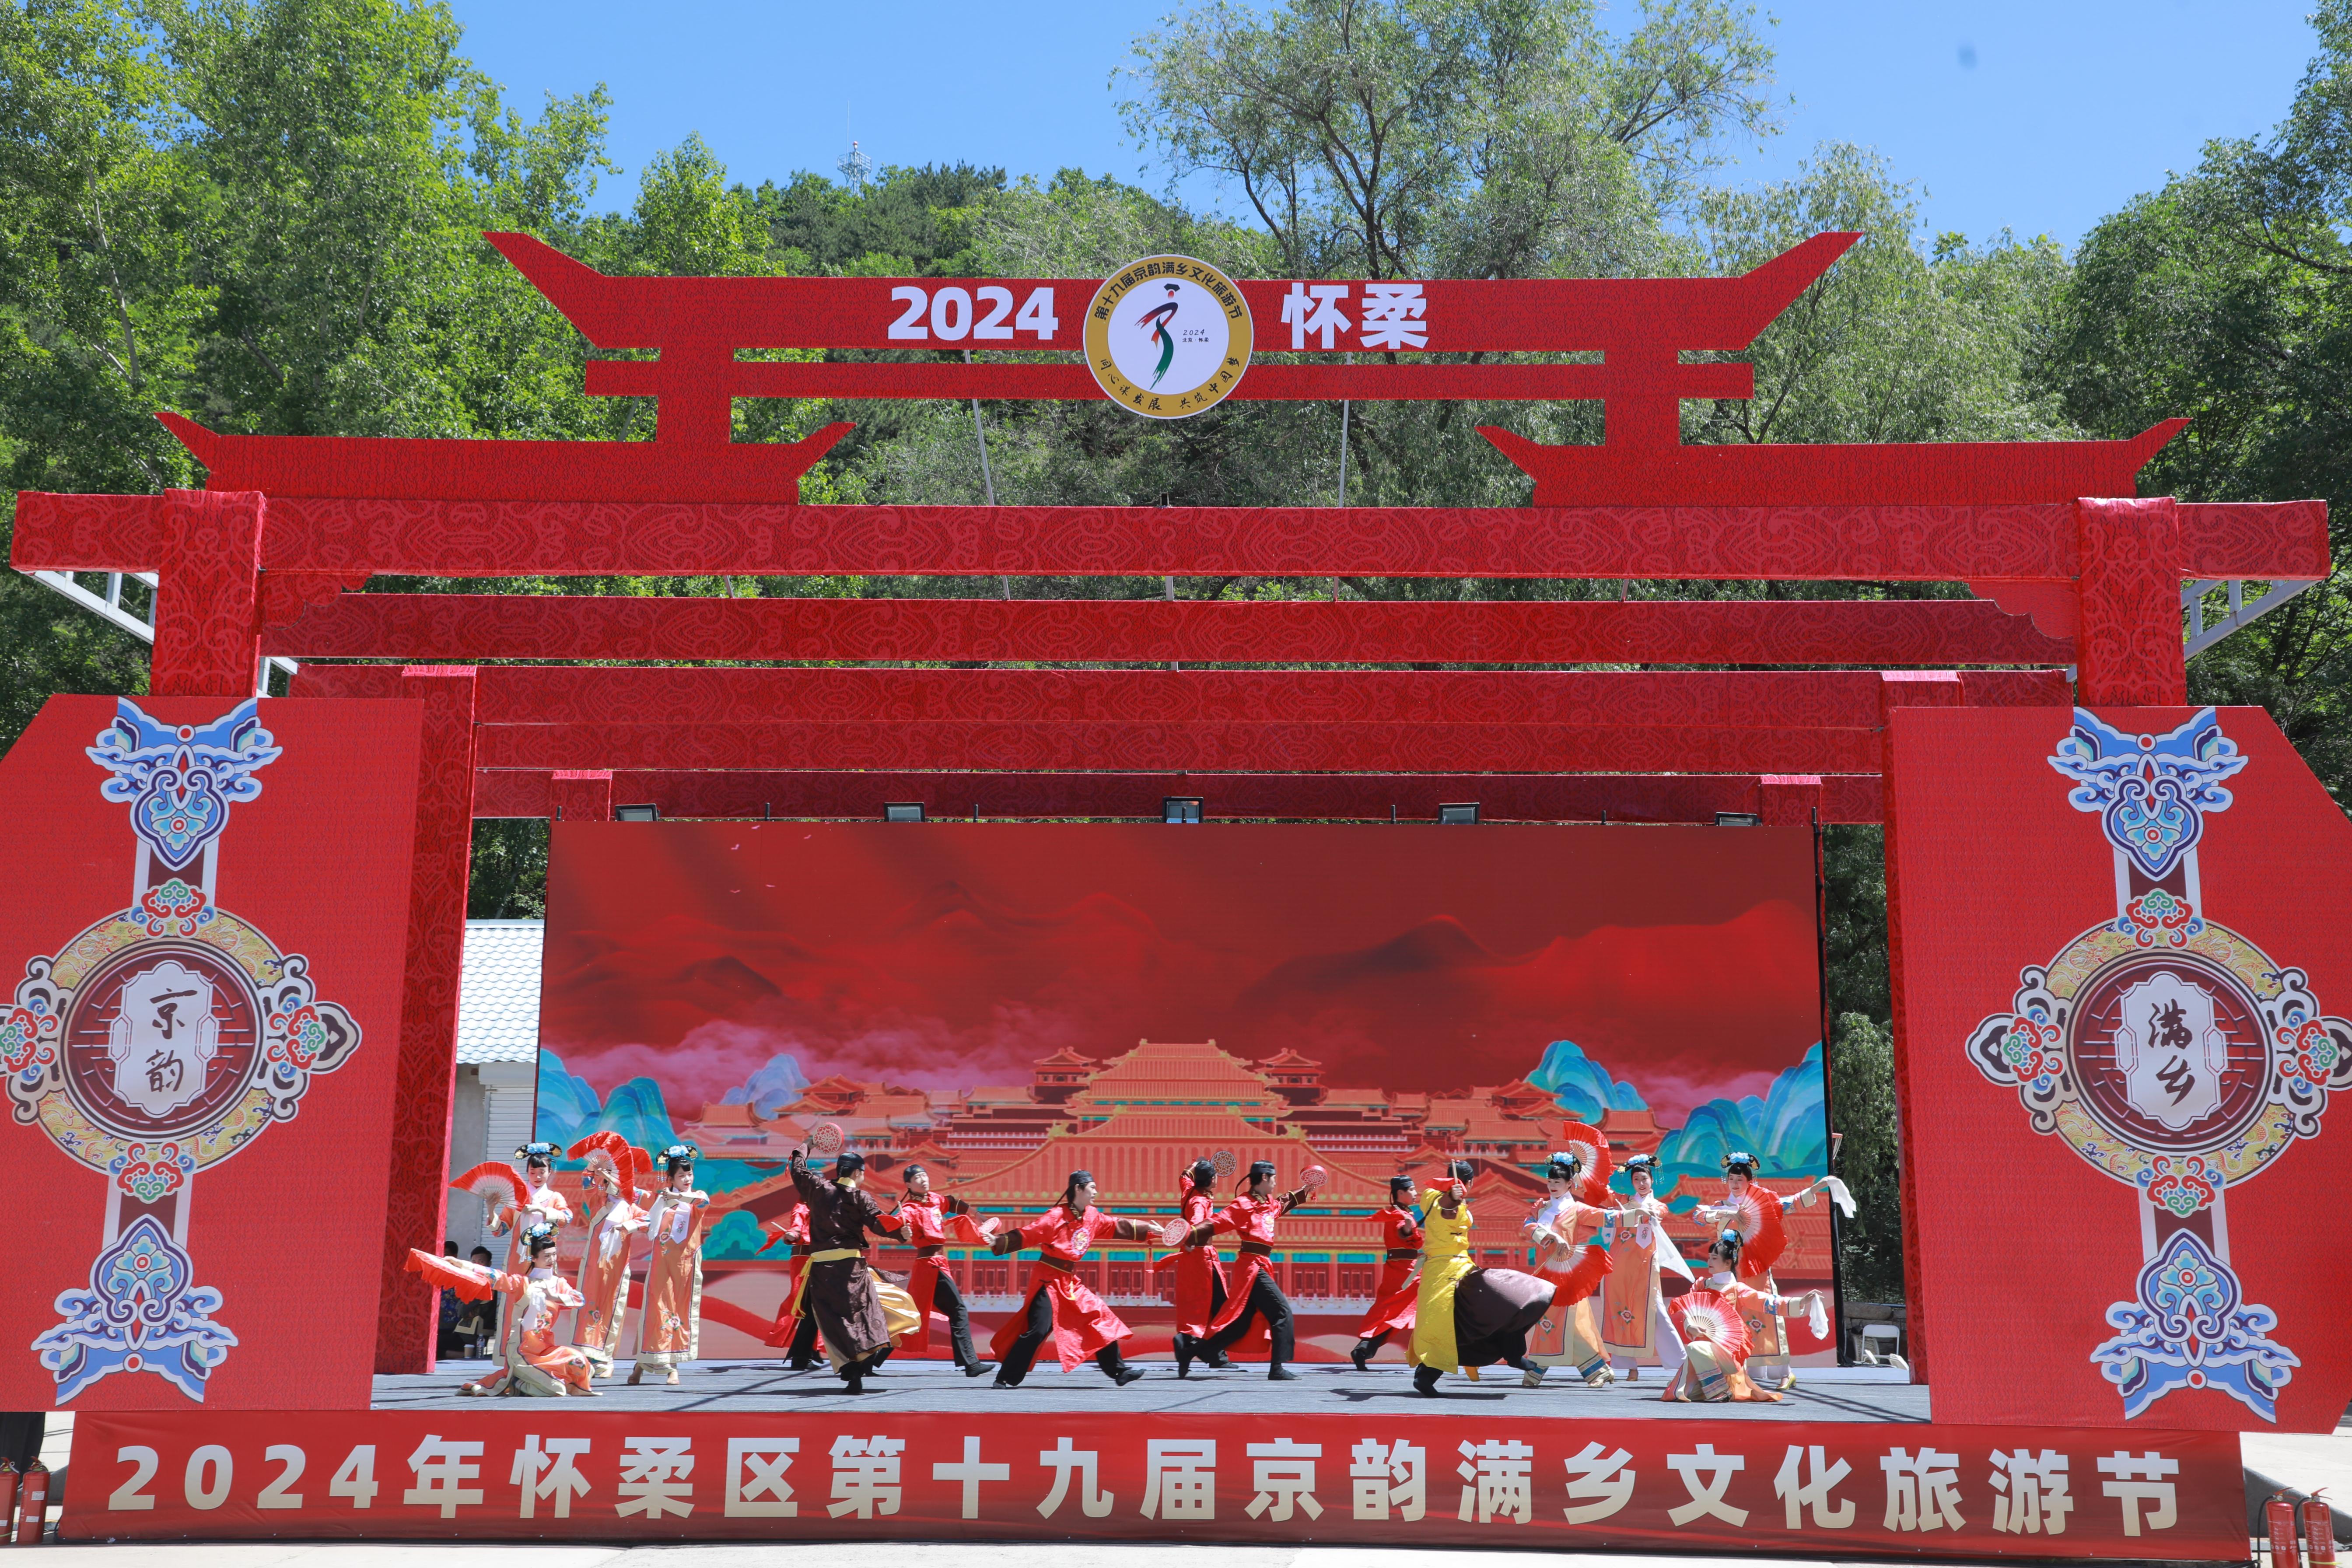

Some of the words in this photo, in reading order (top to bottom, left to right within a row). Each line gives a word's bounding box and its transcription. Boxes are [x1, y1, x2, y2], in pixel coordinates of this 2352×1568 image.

[888, 286, 1059, 340] 2024
[1281, 283, 1428, 349] 怀柔
[1095, 261, 1242, 320] 第十九届京韵满乡文化旅游节
[1100, 358, 1162, 410] 同心谋发展
[1179, 357, 1239, 409] 共筑中国梦
[145, 988, 197, 1093] 京韵
[2148, 999, 2195, 1107] 满乡
[108, 1434, 2180, 1536] 2024年怀柔区第十九届京韵满乡文化旅游节
